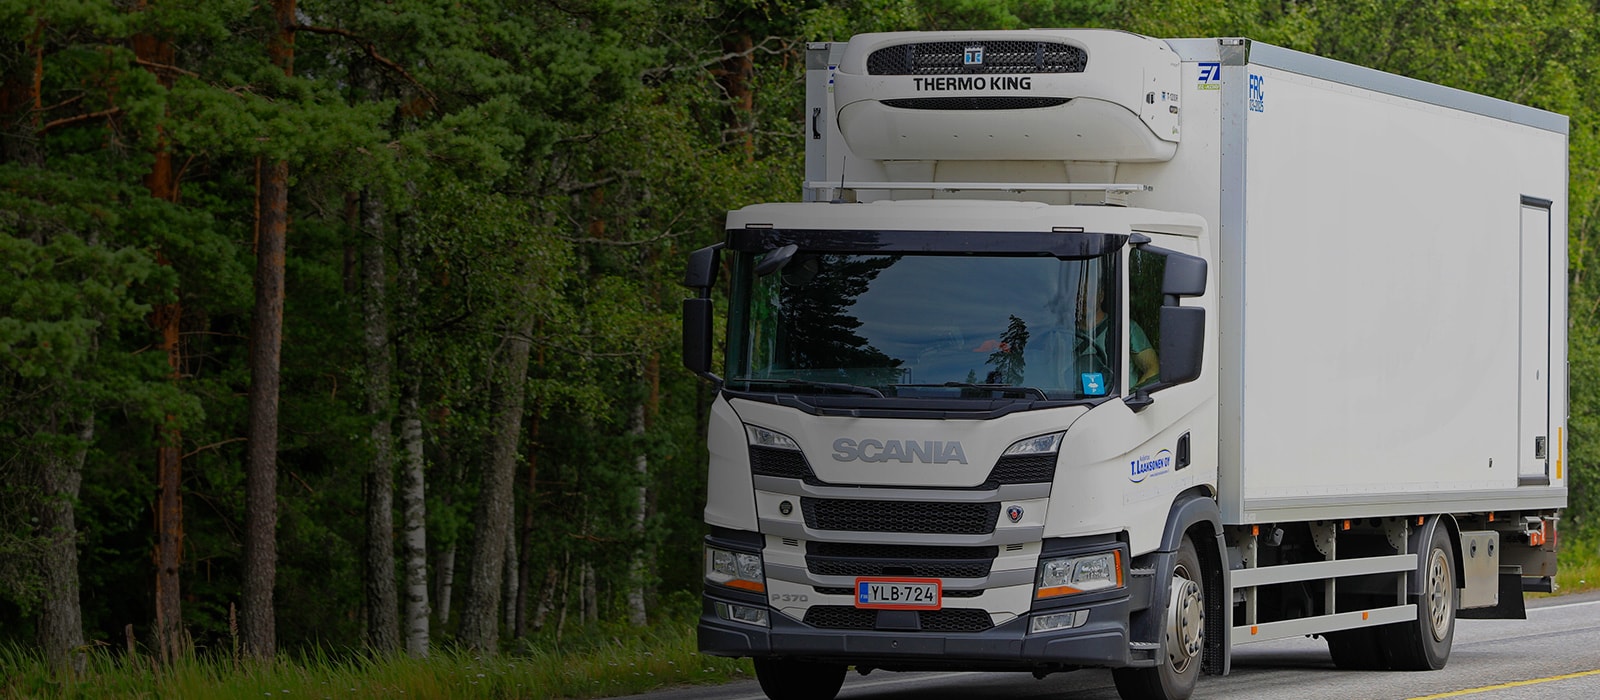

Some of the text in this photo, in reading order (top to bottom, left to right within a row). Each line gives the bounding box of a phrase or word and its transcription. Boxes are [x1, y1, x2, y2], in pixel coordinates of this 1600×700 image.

[913, 77, 1032, 91] THERMO KING
[1249, 74, 1264, 101] FRC
[831, 437, 969, 465] SCANIA
[771, 594, 808, 602] P 370
[871, 585, 934, 602] YLB-724
